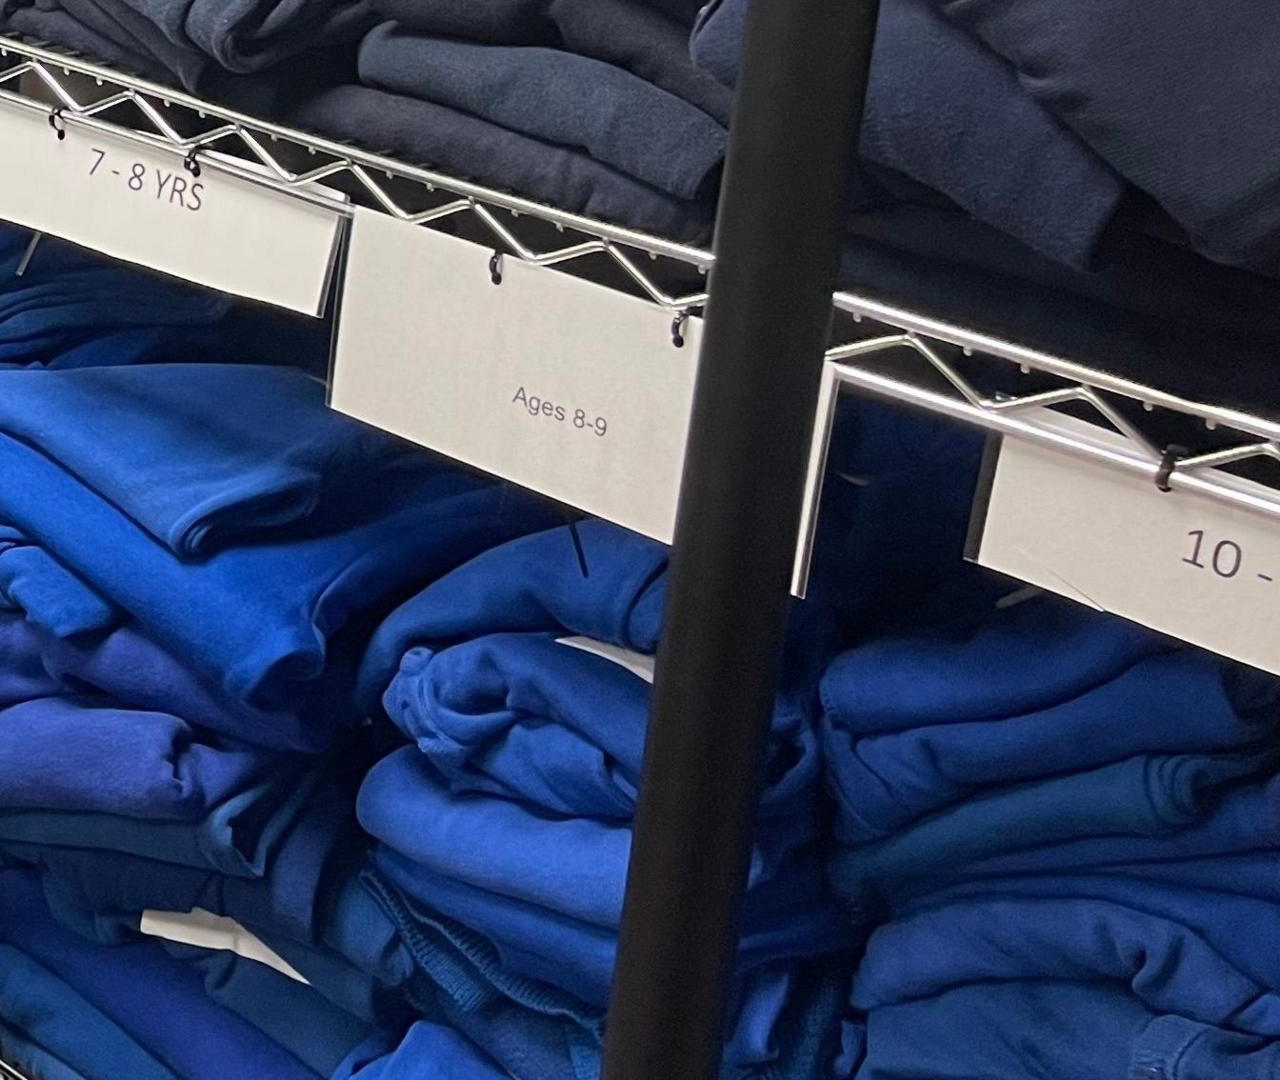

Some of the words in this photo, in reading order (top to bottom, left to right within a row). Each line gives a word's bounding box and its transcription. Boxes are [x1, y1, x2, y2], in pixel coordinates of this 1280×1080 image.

[87, 147, 107, 176] 7
[127, 162, 147, 191] 8
[154, 169, 205, 212] YRS
[512, 386, 566, 422] Ages
[572, 408, 608, 437] 8-9
[1181, 529, 1242, 578] 10
